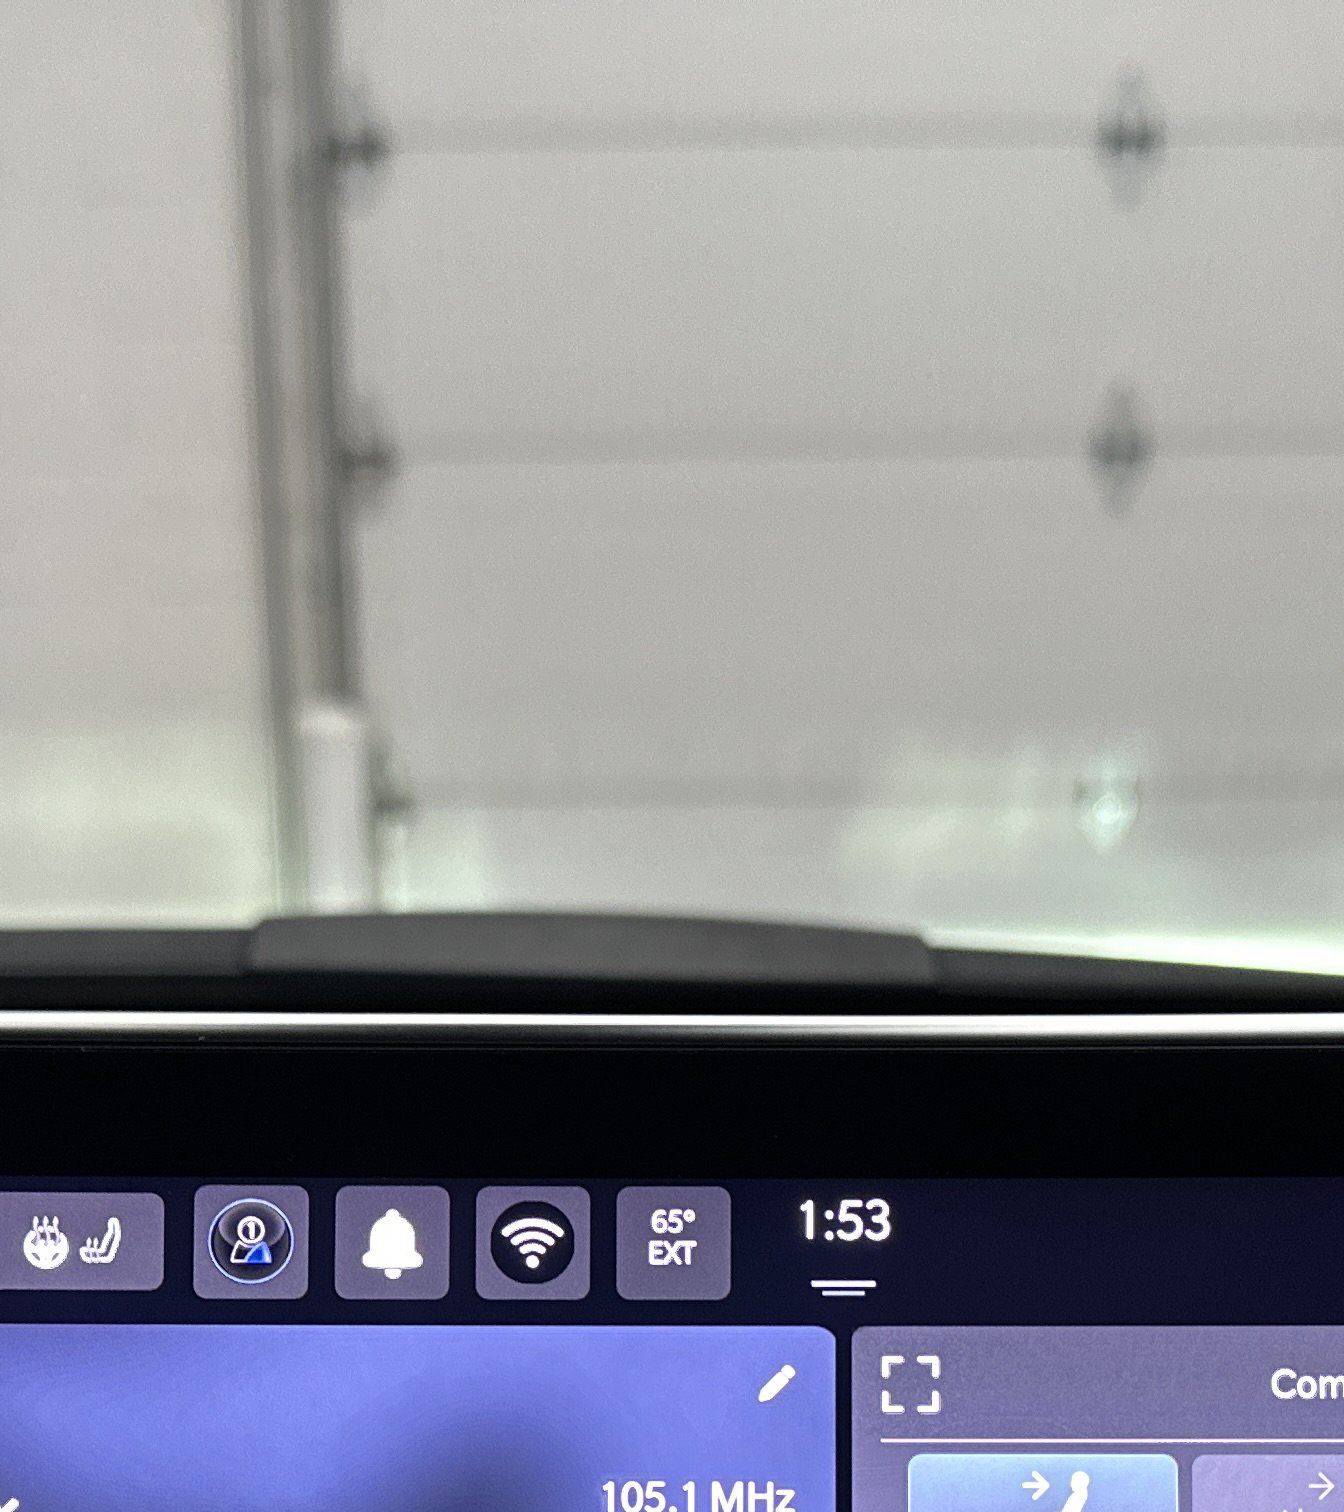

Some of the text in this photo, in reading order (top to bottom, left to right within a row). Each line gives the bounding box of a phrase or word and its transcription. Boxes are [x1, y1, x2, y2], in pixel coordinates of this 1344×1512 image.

[650, 1207, 697, 1235] 65°
[798, 1197, 892, 1243] 1:53
[647, 1239, 699, 1267] EXT
